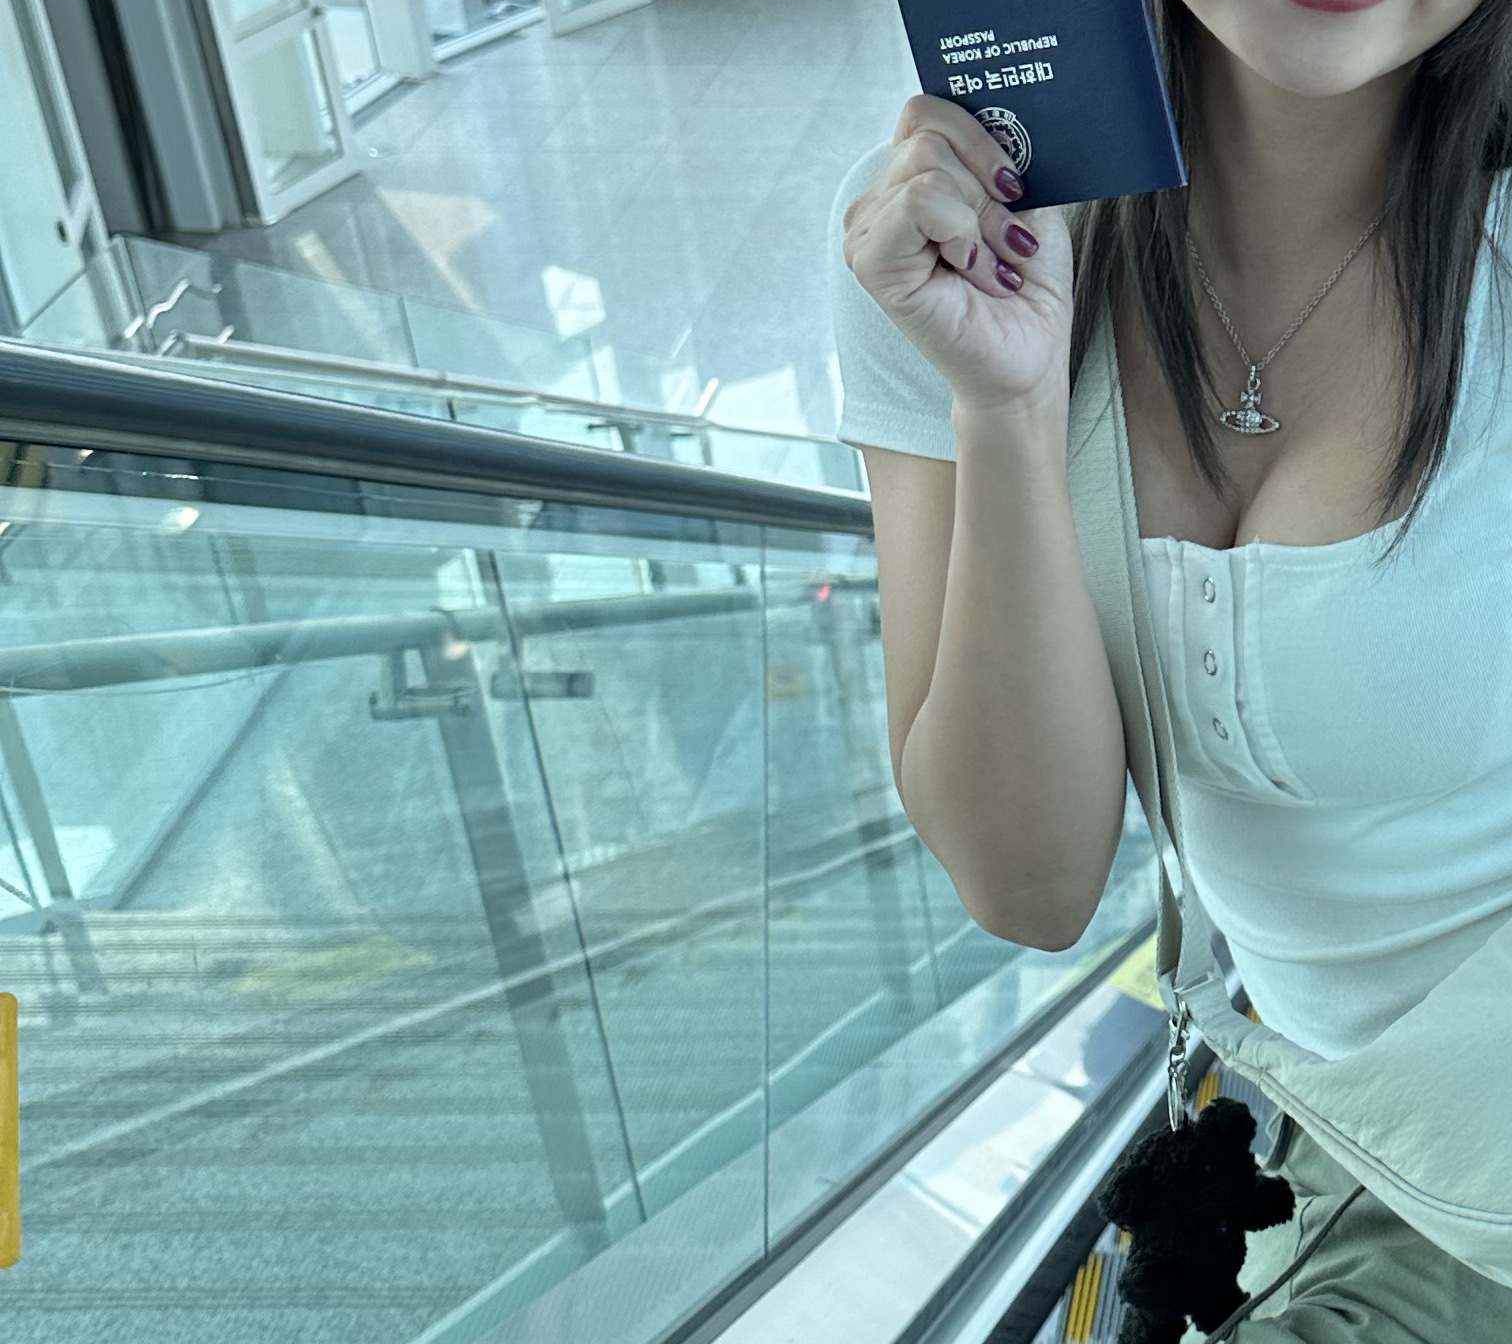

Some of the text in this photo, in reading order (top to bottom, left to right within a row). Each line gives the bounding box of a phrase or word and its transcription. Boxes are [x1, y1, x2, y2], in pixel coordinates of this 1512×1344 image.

[939, 29, 995, 50] PASSPORT
[942, 35, 1058, 64] REPUBLIC OF KOREA
[947, 61, 1054, 97] 대한민국 여권
